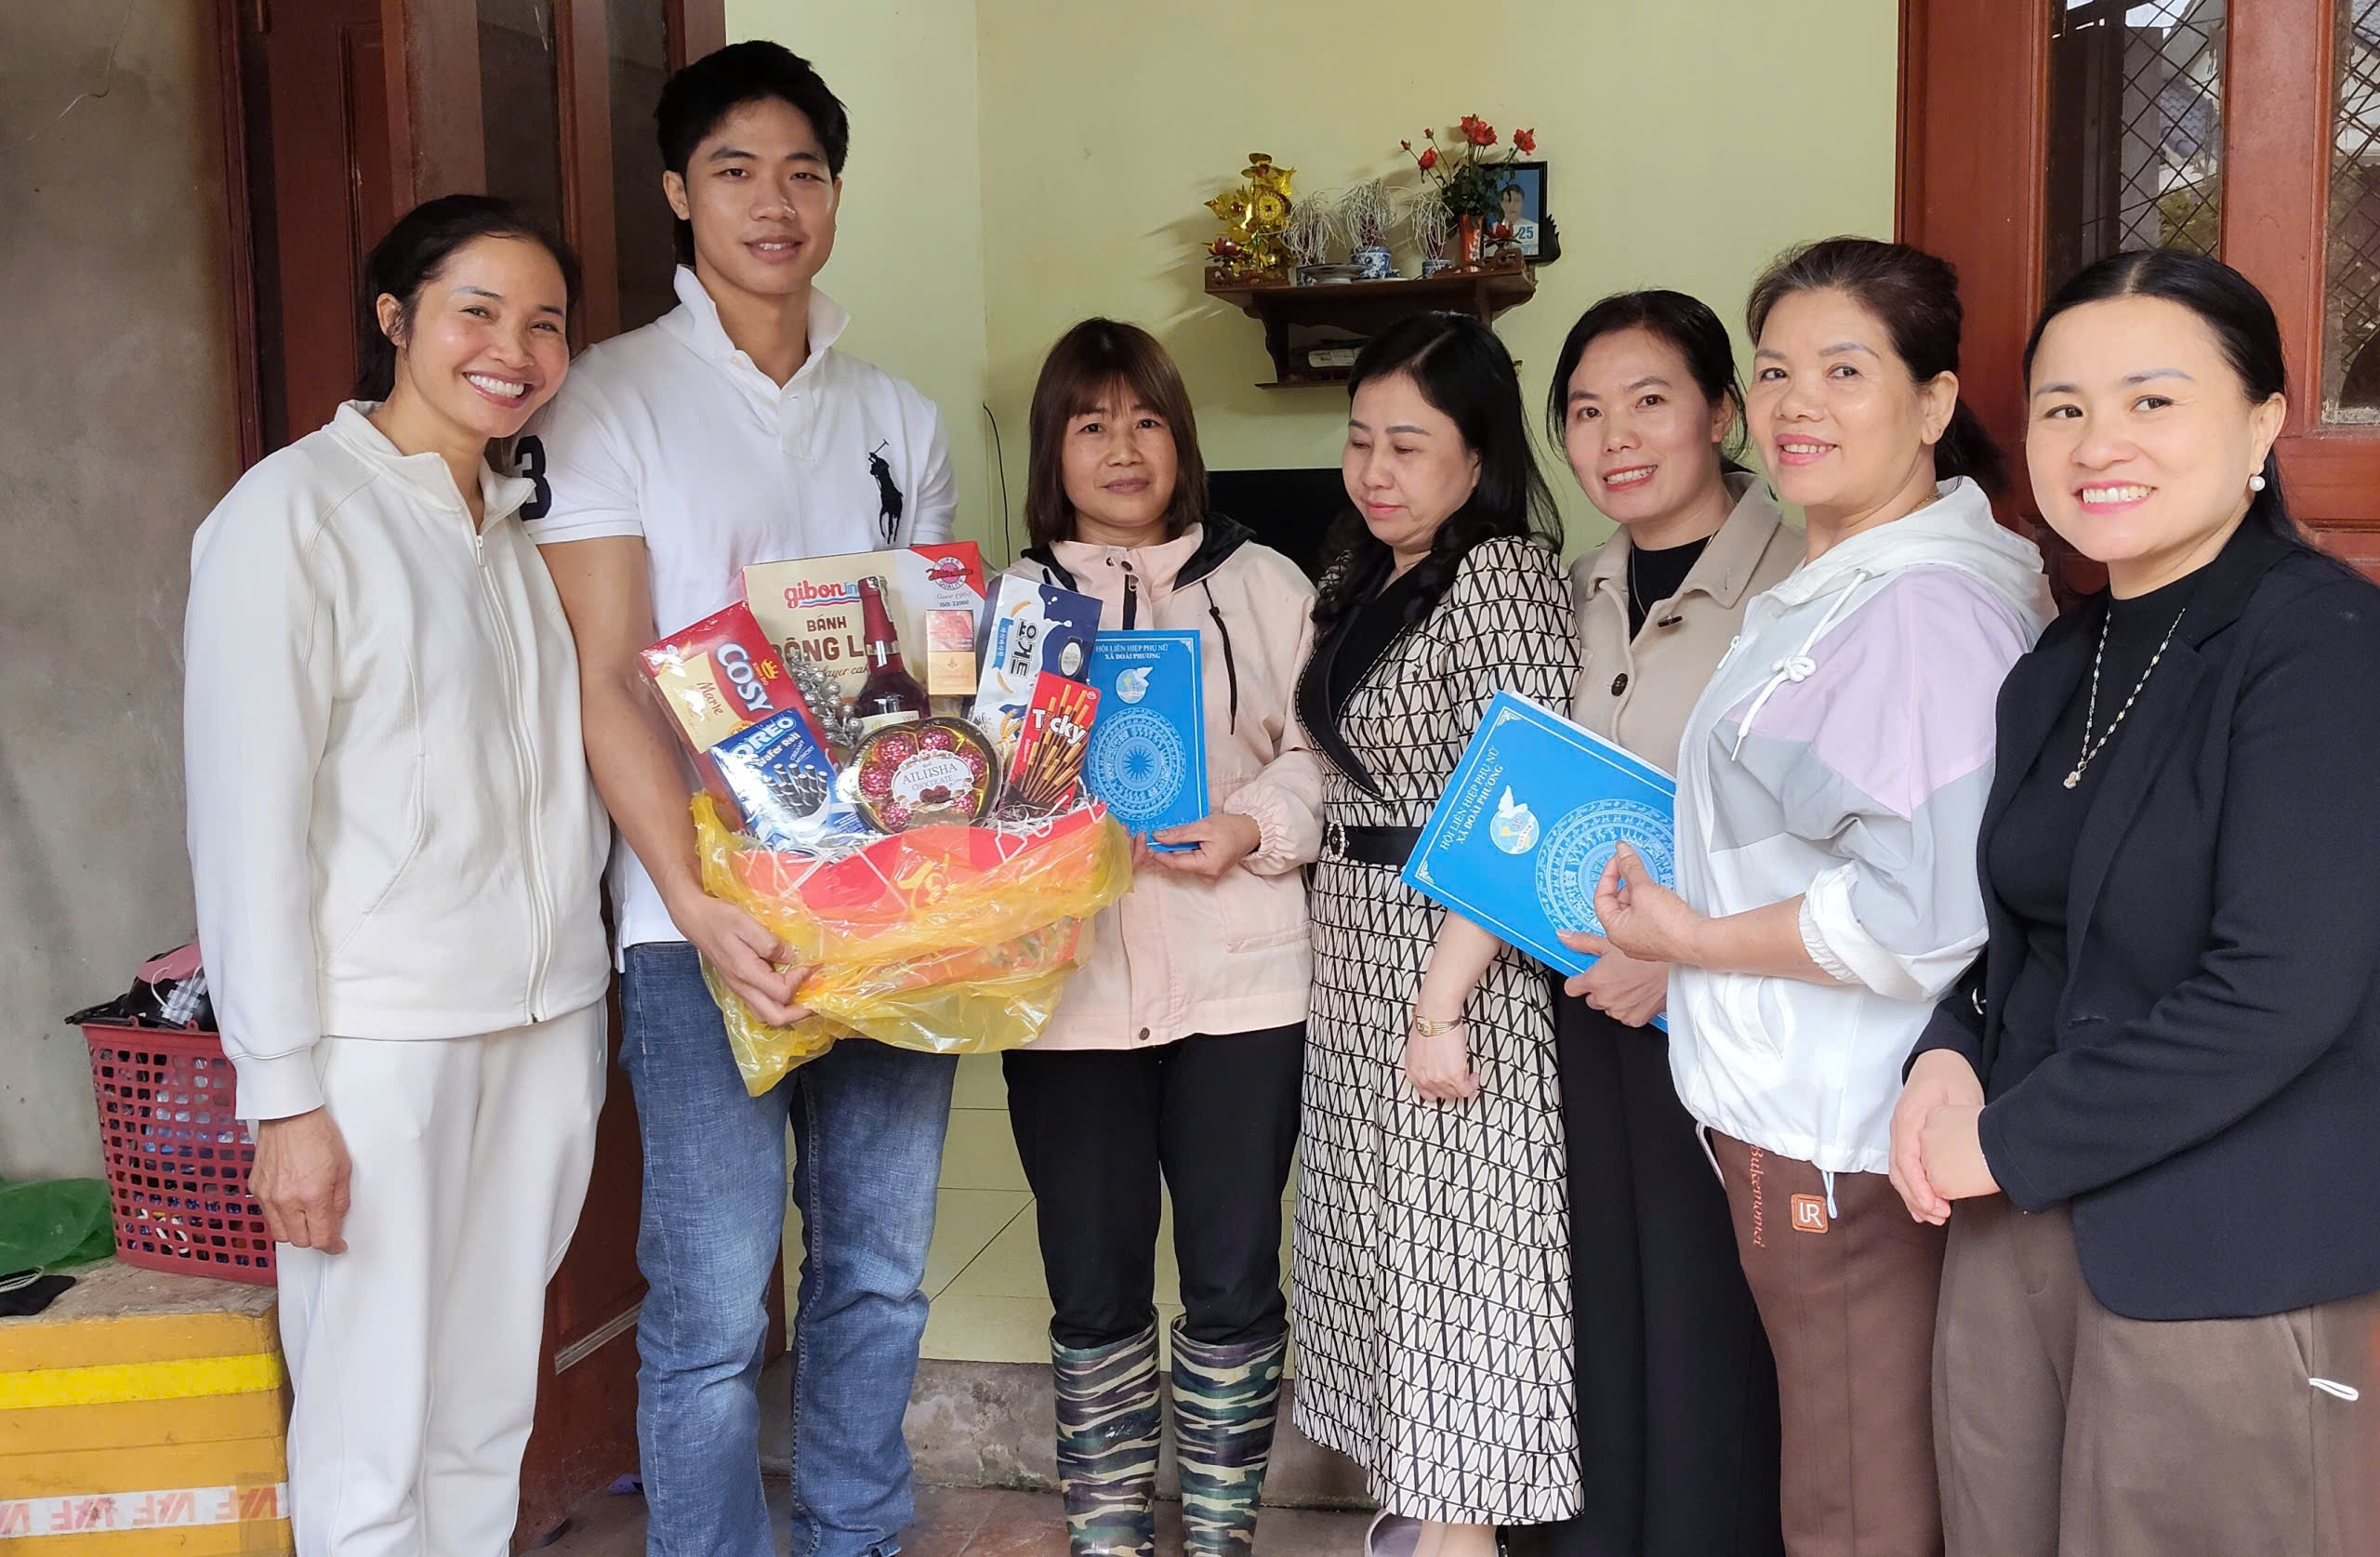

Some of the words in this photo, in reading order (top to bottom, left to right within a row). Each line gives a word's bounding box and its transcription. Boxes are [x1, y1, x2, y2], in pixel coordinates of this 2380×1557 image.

[1519, 227, 1533, 239] 25
[515, 435, 551, 521] 3
[806, 614, 847, 632] BÁNH
[1011, 621, 1038, 677] 요거트
[717, 642, 774, 712] COSY
[697, 681, 724, 716] Marie
[731, 718, 795, 759] OREO
[781, 732, 801, 747] Roll
[1032, 708, 1087, 744] Ticky
[1440, 832, 1455, 851] HỘI
[1449, 807, 1468, 832] LIÊN
[1462, 784, 1480, 809] HIỆP
[1474, 764, 1490, 785] PHỤ
[1486, 746, 1500, 764] NỮ
[1456, 829, 1468, 845] XÃ
[1463, 806, 1482, 829] ĐOÀI
[1477, 765, 1503, 806] PHƯƠNG
